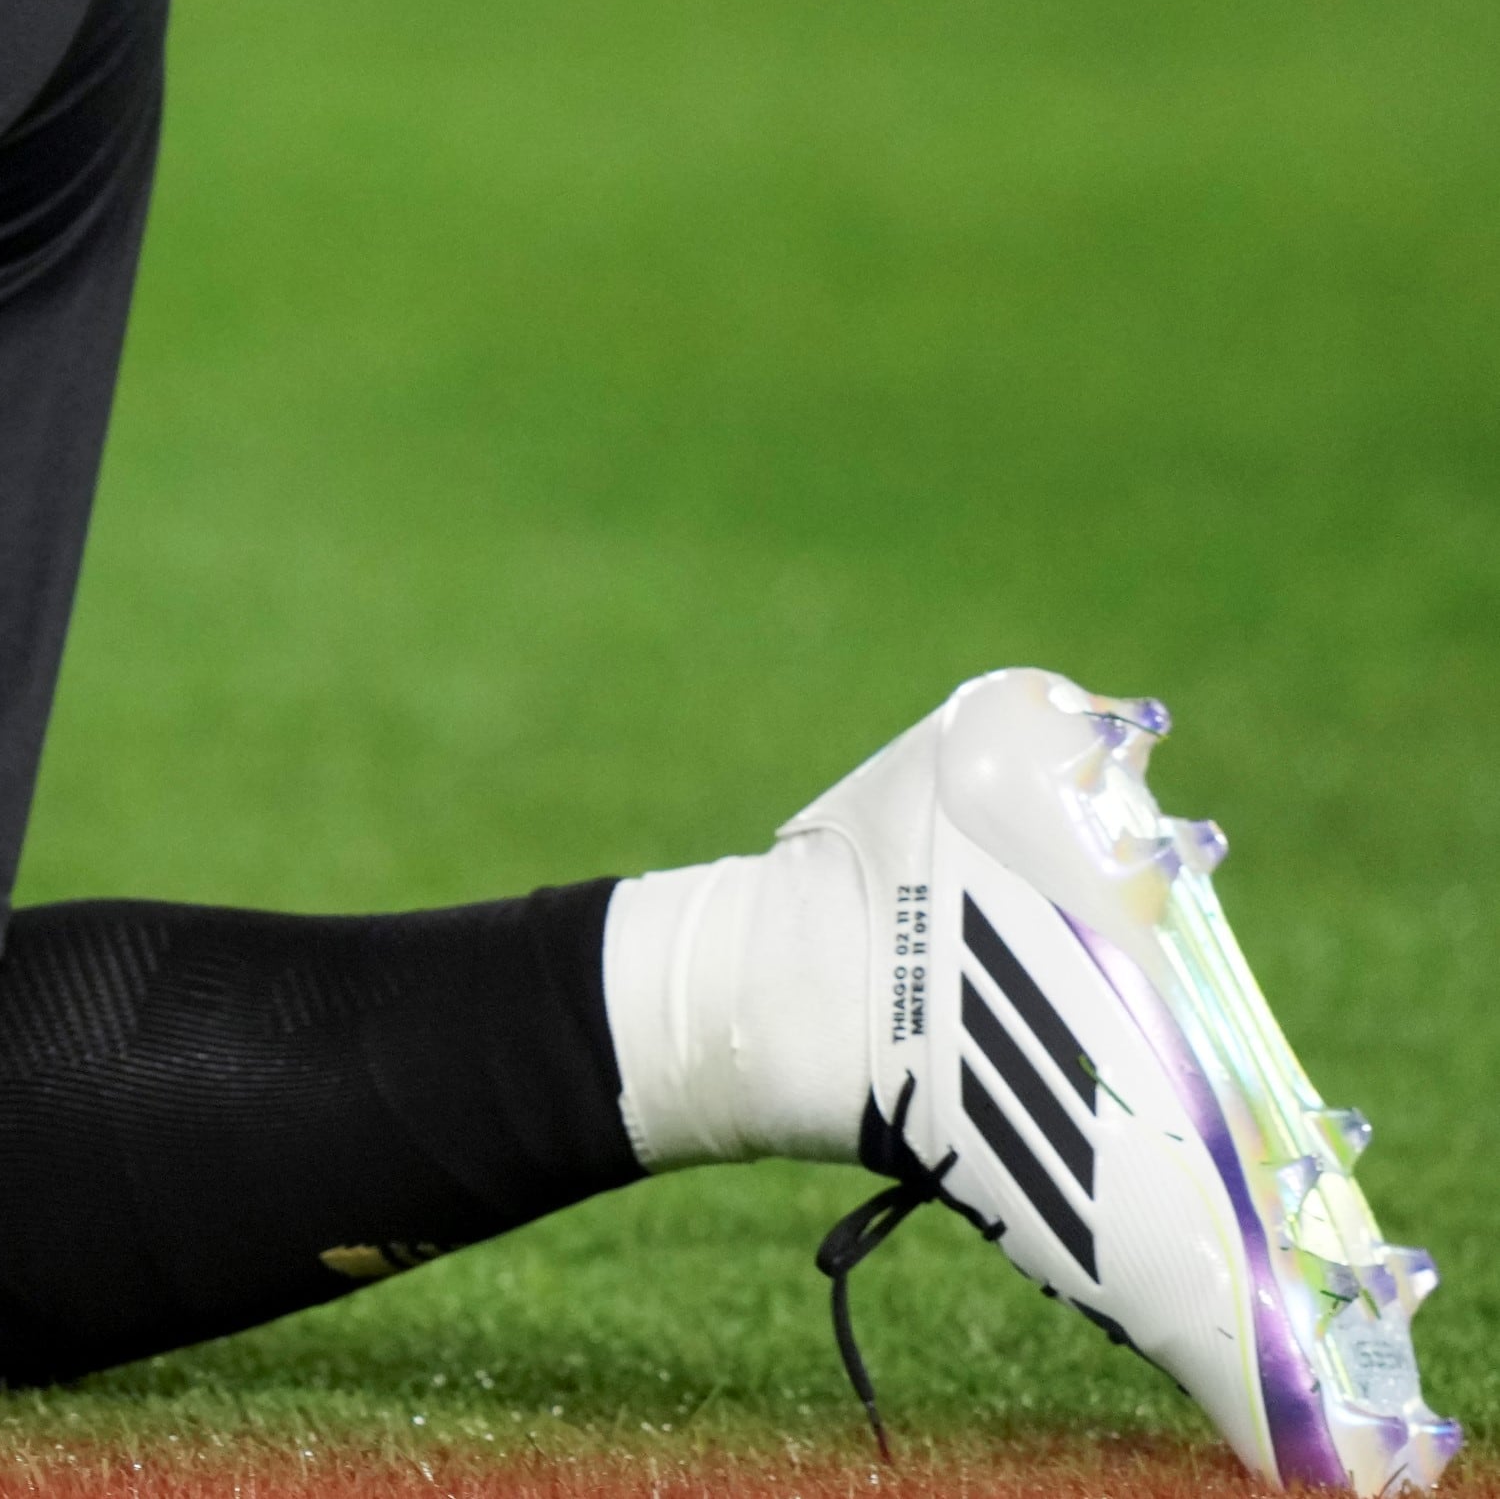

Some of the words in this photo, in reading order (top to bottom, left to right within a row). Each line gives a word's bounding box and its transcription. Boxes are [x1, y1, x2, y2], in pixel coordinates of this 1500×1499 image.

[897, 885, 911, 902] 12
[896, 911, 910, 924] 11
[913, 911, 928, 934] 09
[895, 933, 910, 956] 02
[912, 942, 927, 955] 11
[893, 966, 908, 1044] THIAGO
[911, 966, 926, 1035] MATEO
